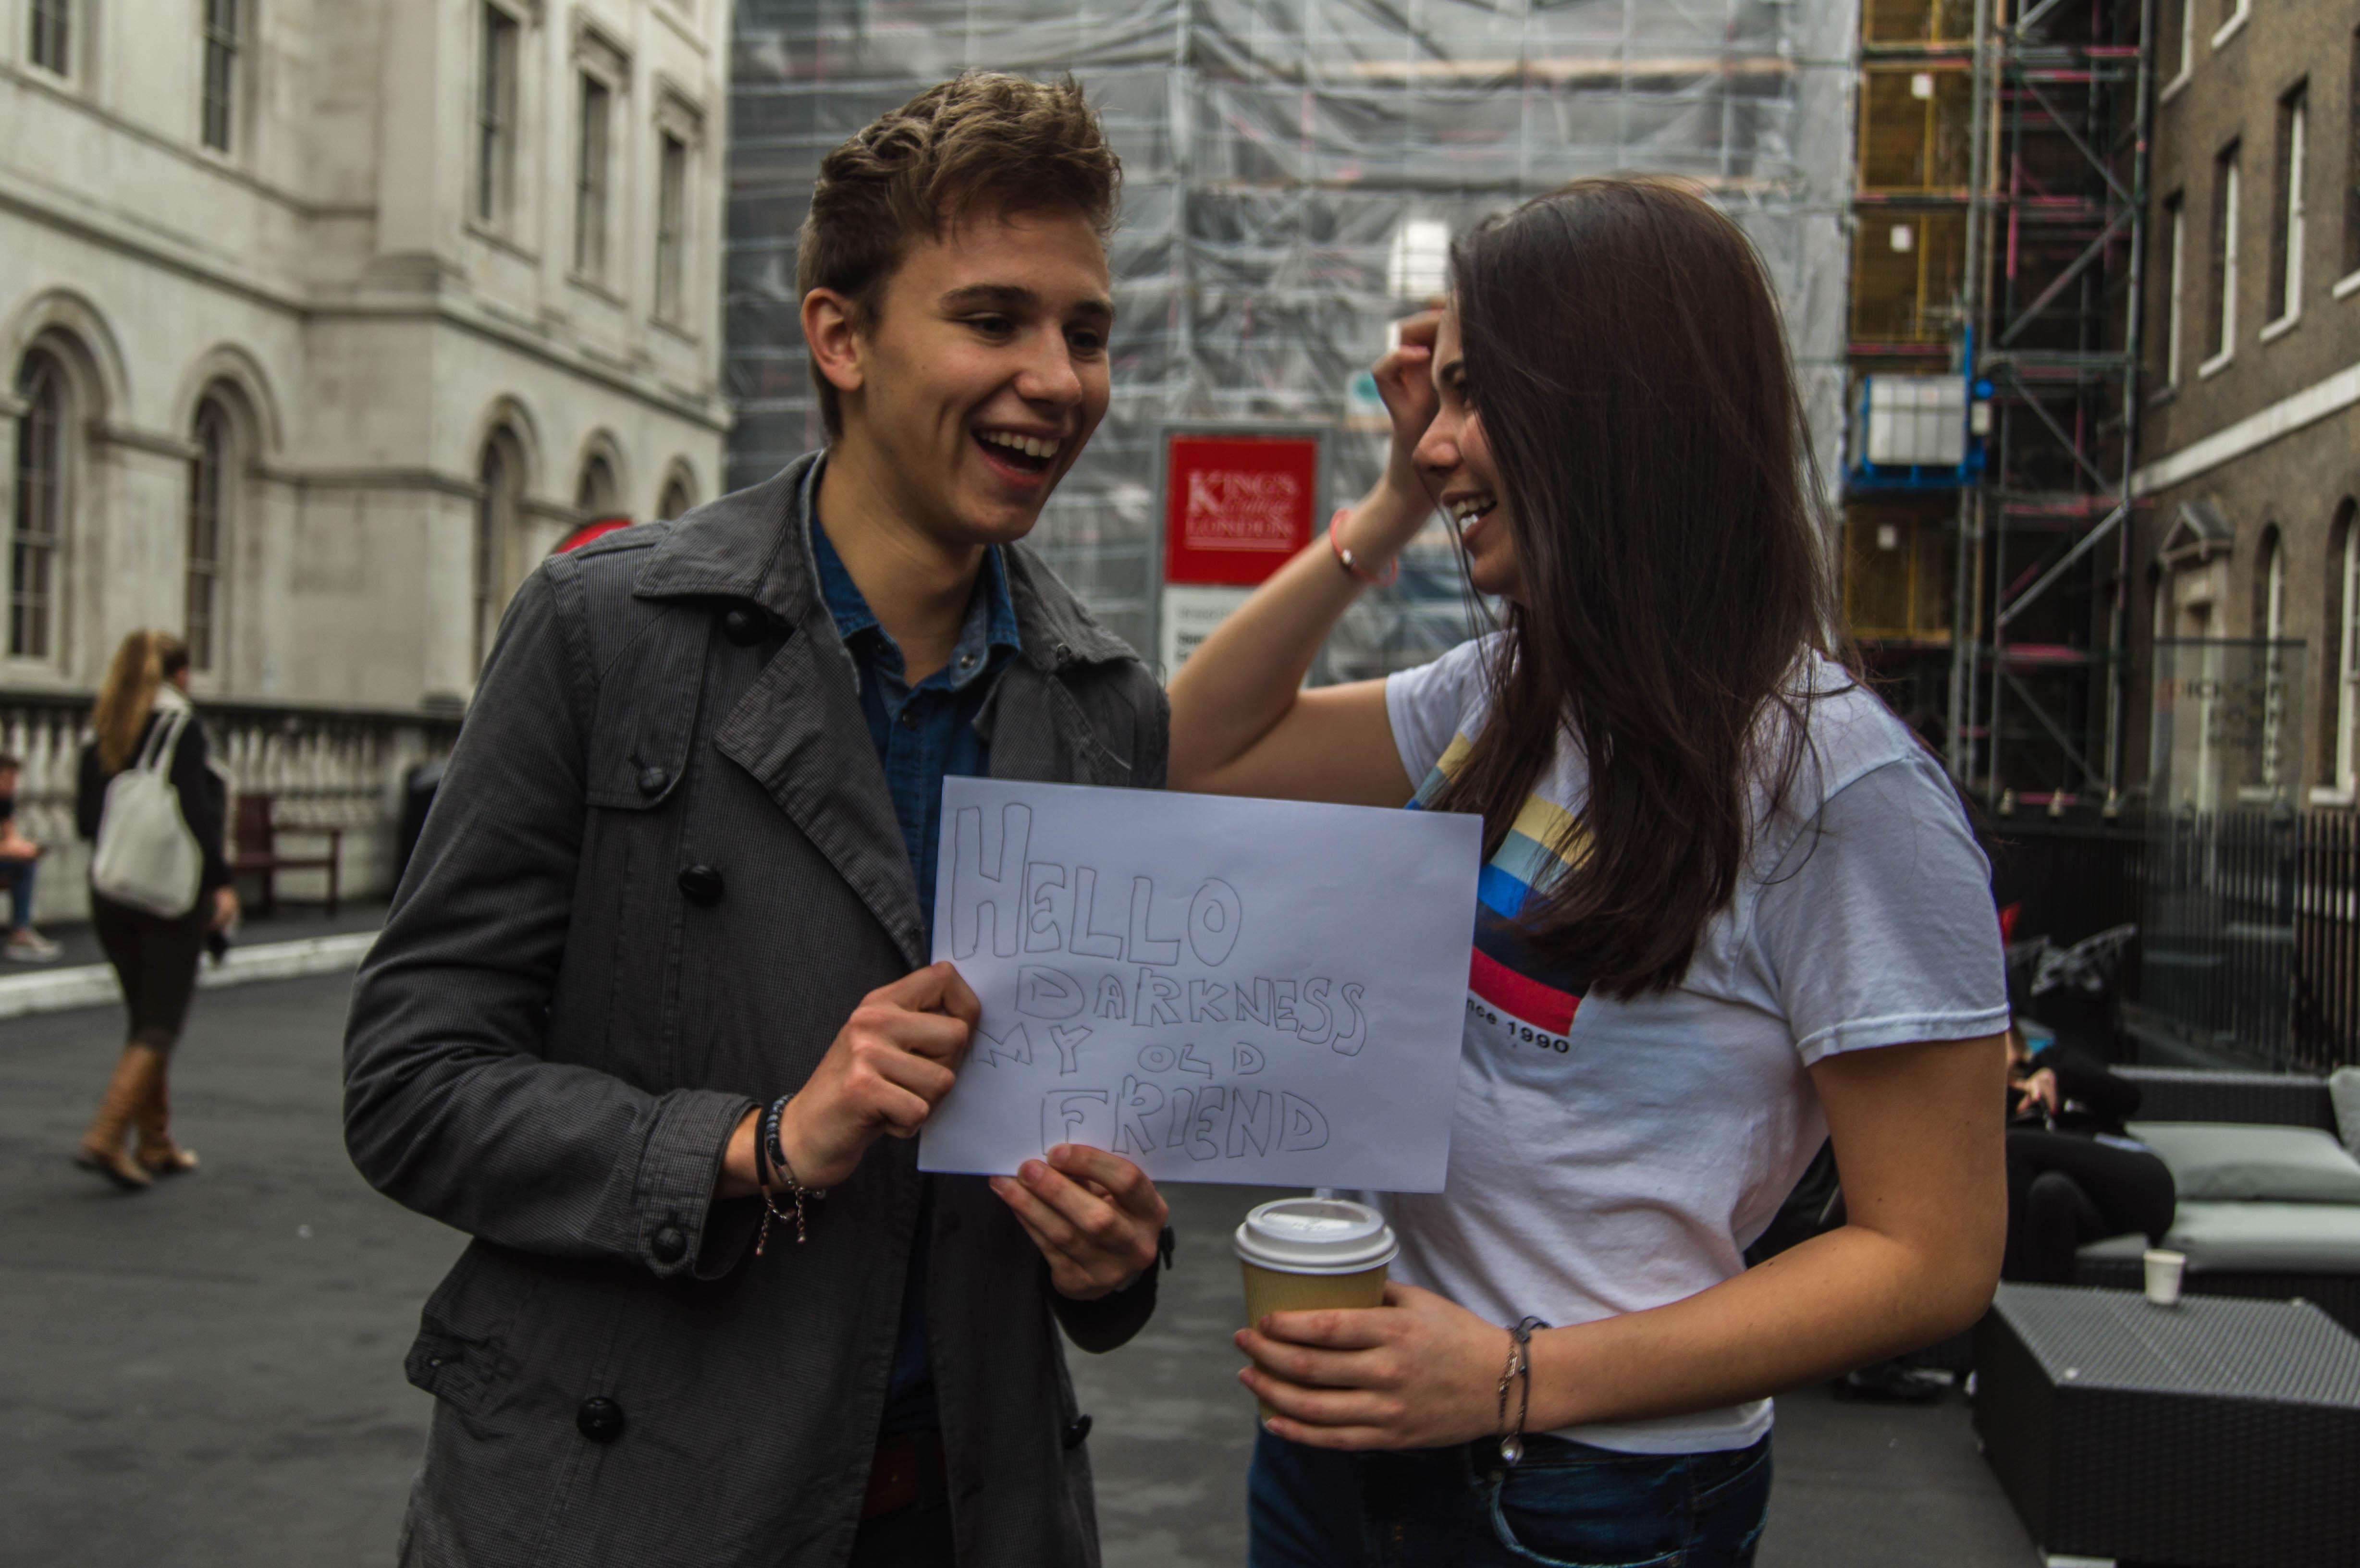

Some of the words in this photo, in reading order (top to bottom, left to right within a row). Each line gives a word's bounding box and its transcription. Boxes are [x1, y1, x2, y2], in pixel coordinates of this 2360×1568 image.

[951, 802, 1242, 966] HELLO
[971, 1022, 1093, 1076] MY
[1138, 1041, 1266, 1079] OLD
[1015, 967, 1367, 1056] DARKNESS
[1466, 996, 1497, 1025] nce
[1508, 1020, 1570, 1054] 1990
[1041, 1074, 1330, 1161] FRIEND
